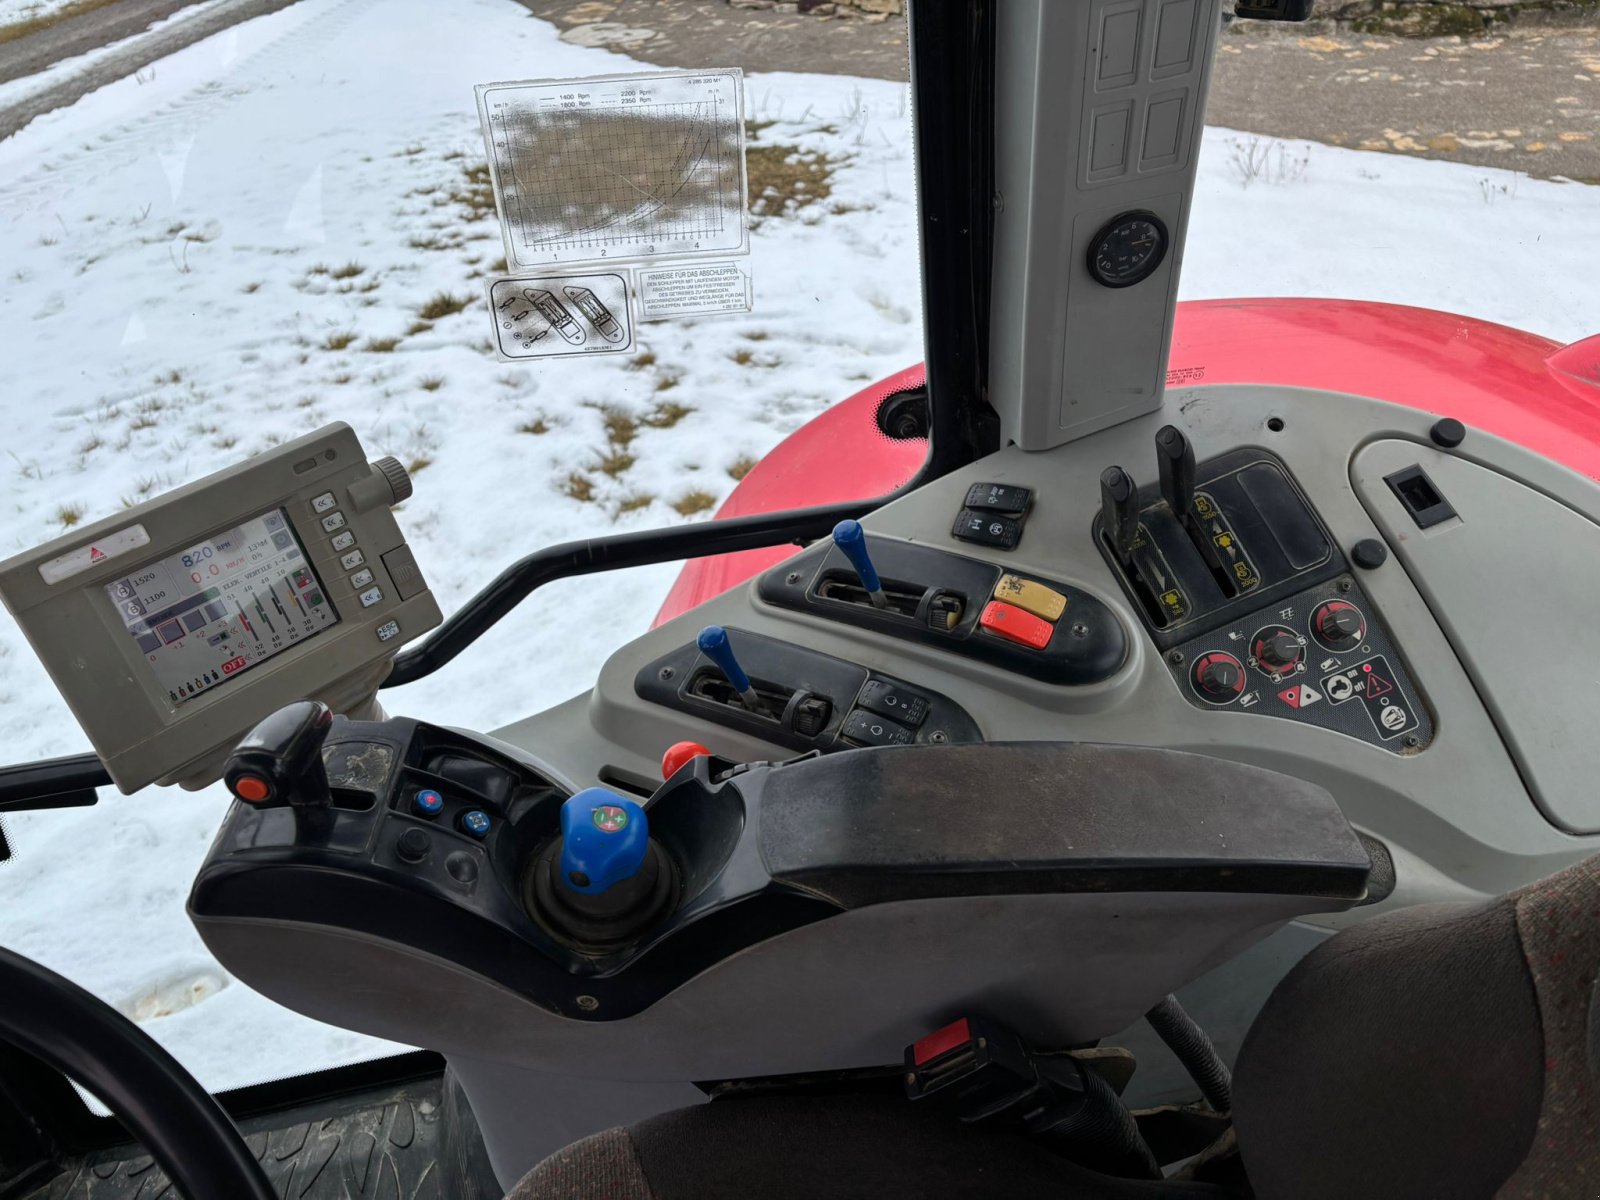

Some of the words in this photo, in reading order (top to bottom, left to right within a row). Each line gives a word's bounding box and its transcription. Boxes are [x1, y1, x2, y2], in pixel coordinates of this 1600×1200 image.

[700, 268, 738, 276] ABSCHLEPPEN
[182, 546, 212, 567] 820
[216, 541, 231, 551] RPM
[192, 564, 219, 583] 0.0
[244, 564, 272, 579] VENTILE
[134, 573, 155, 587] 1520
[1242, 577, 1257, 587] 2000
[144, 591, 166, 604] 1100
[381, 622, 396, 633] ESC
[223, 656, 246, 672] OFF
[1249, 658, 1258, 666] 2
[1297, 663, 1304, 672] 4
[1273, 673, 1280, 682] 3
[1347, 670, 1358, 679] on
[1354, 681, 1365, 692] off
